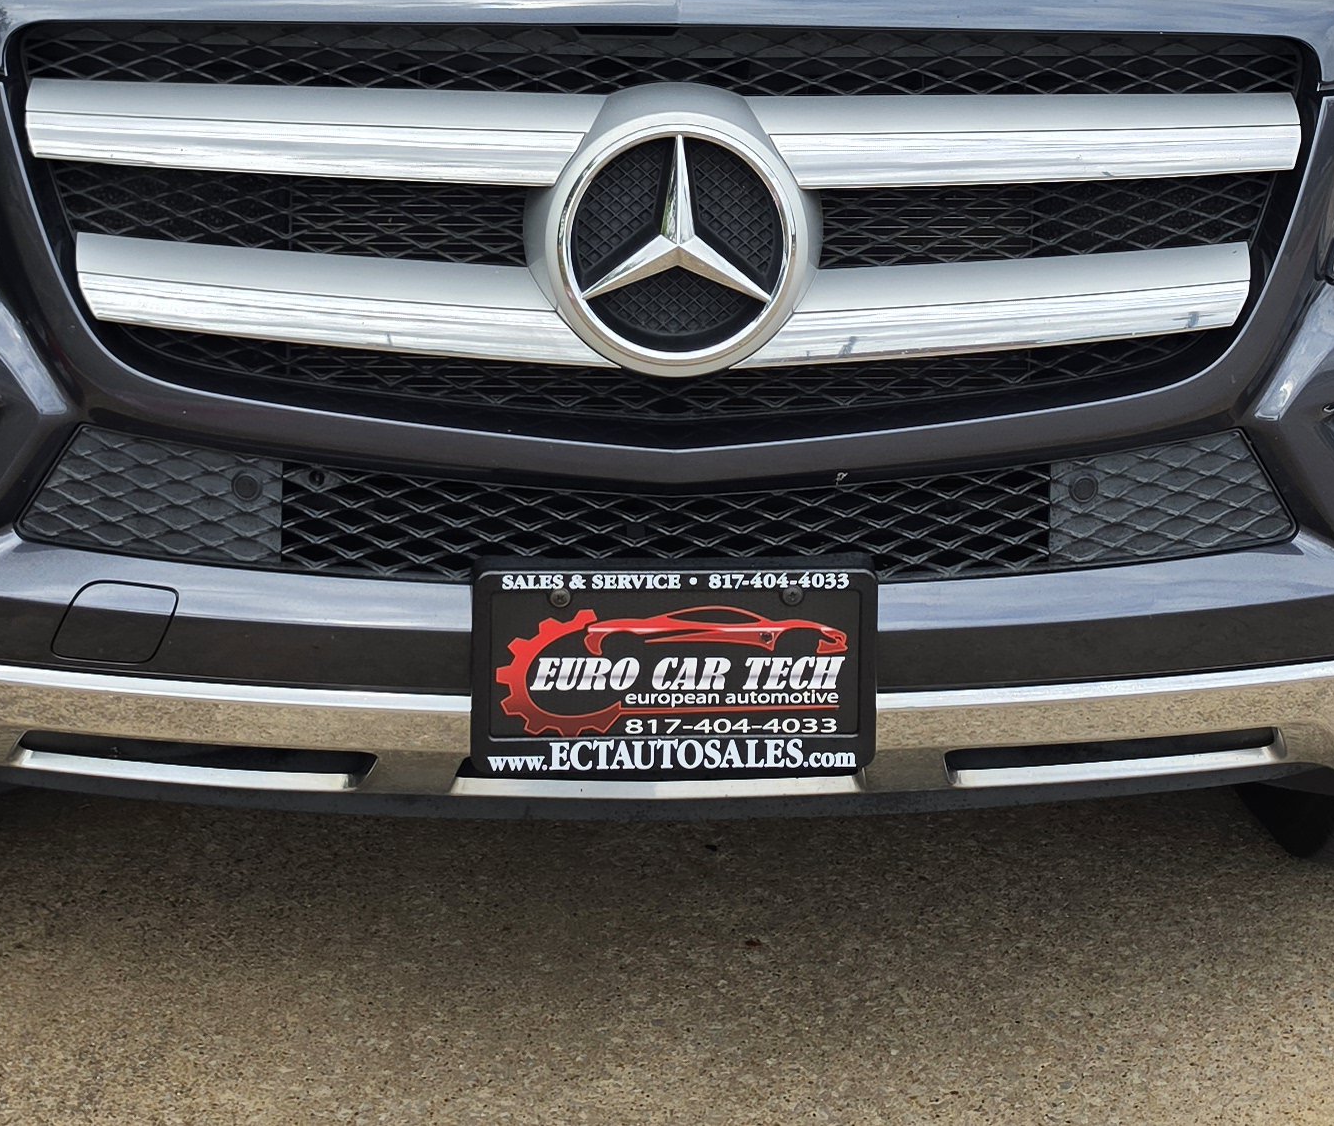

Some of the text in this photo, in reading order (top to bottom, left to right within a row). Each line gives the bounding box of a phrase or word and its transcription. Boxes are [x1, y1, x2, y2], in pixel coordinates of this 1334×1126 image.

[502, 573, 850, 590] SALES & SERVICE 817-404-4033
[530, 655, 848, 692] EURO CAR TECH
[625, 690, 839, 708] european automotive
[625, 717, 838, 735] 817-404-4033
[487, 739, 857, 772] www.ECTAUTOSALES.com
